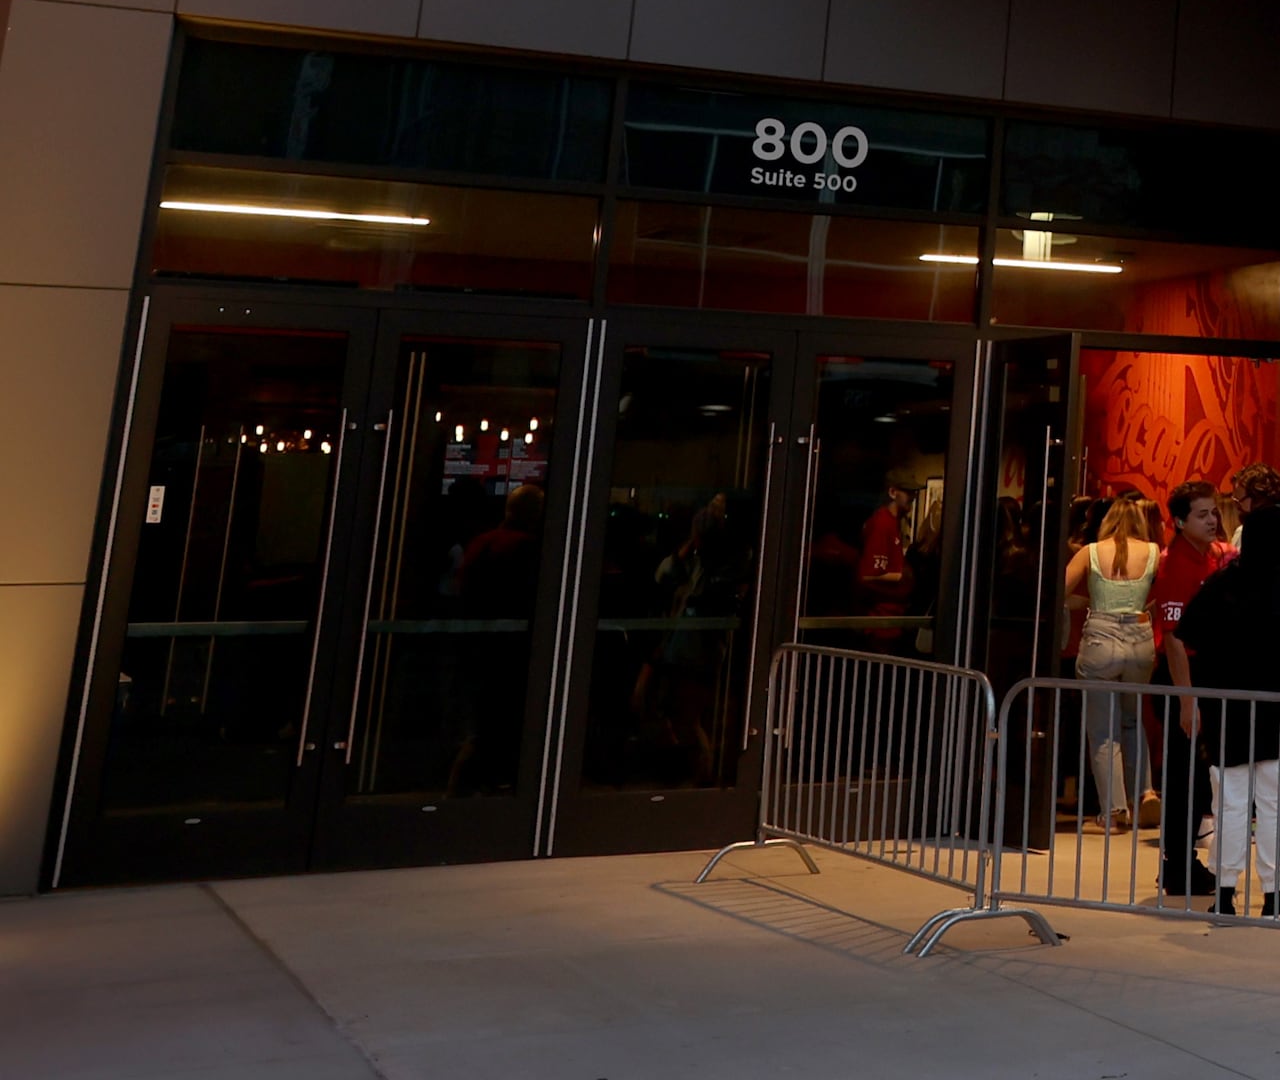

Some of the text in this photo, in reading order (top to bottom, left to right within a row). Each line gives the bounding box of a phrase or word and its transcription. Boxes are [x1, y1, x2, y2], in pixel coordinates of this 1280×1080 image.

[752, 118, 869, 169] 800
[750, 166, 858, 193] Suite 500
